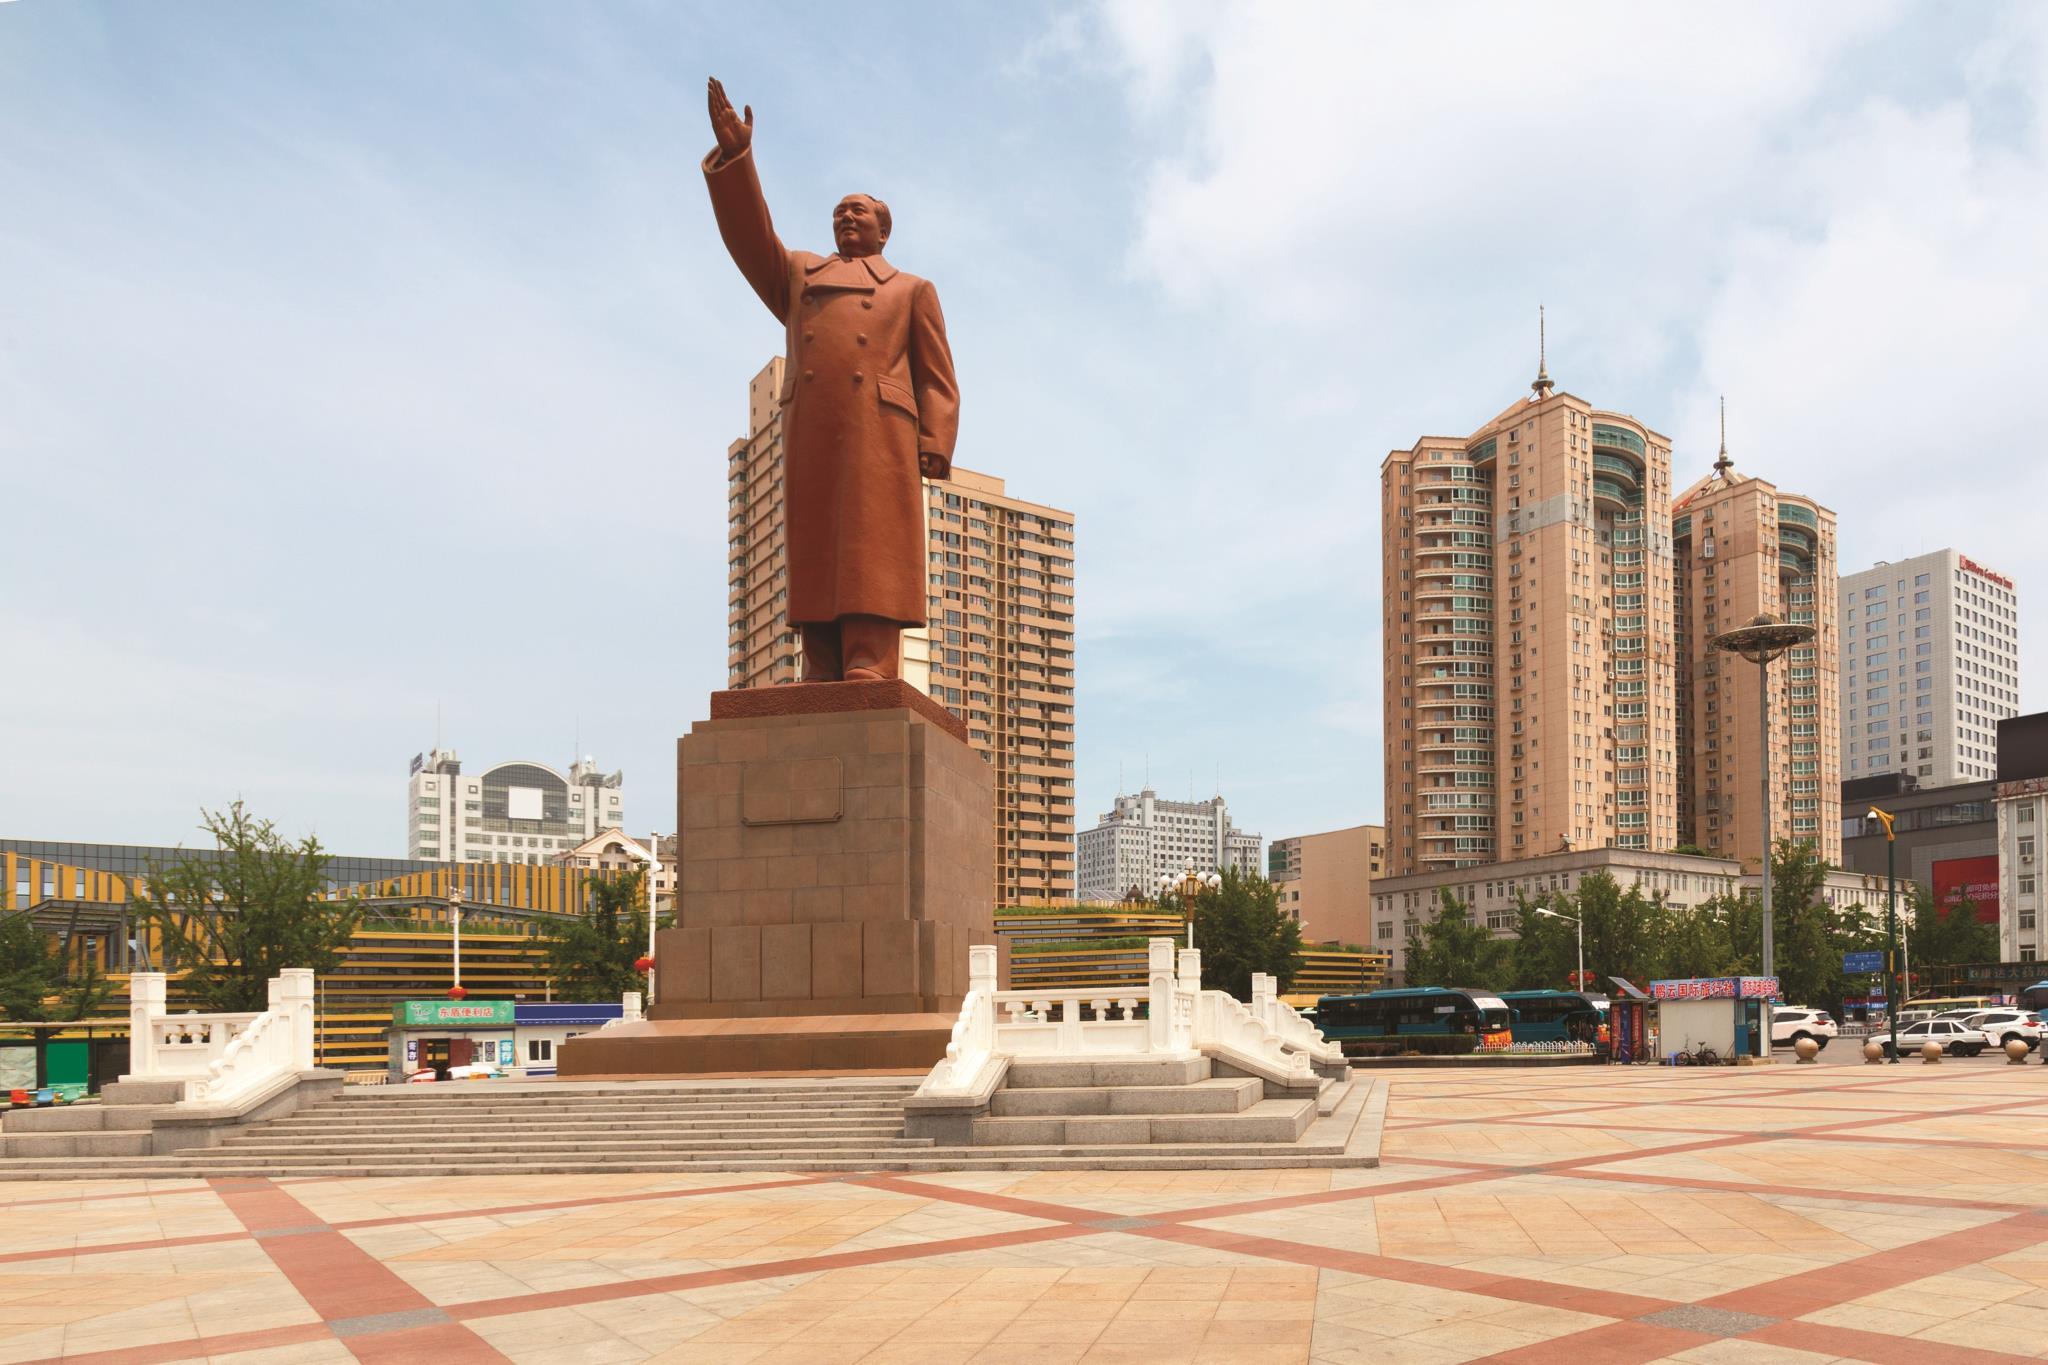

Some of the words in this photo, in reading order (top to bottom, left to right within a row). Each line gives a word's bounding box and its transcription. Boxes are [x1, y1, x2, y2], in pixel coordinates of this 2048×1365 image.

[1655, 981, 1734, 998] 鹏云国际旅行社
